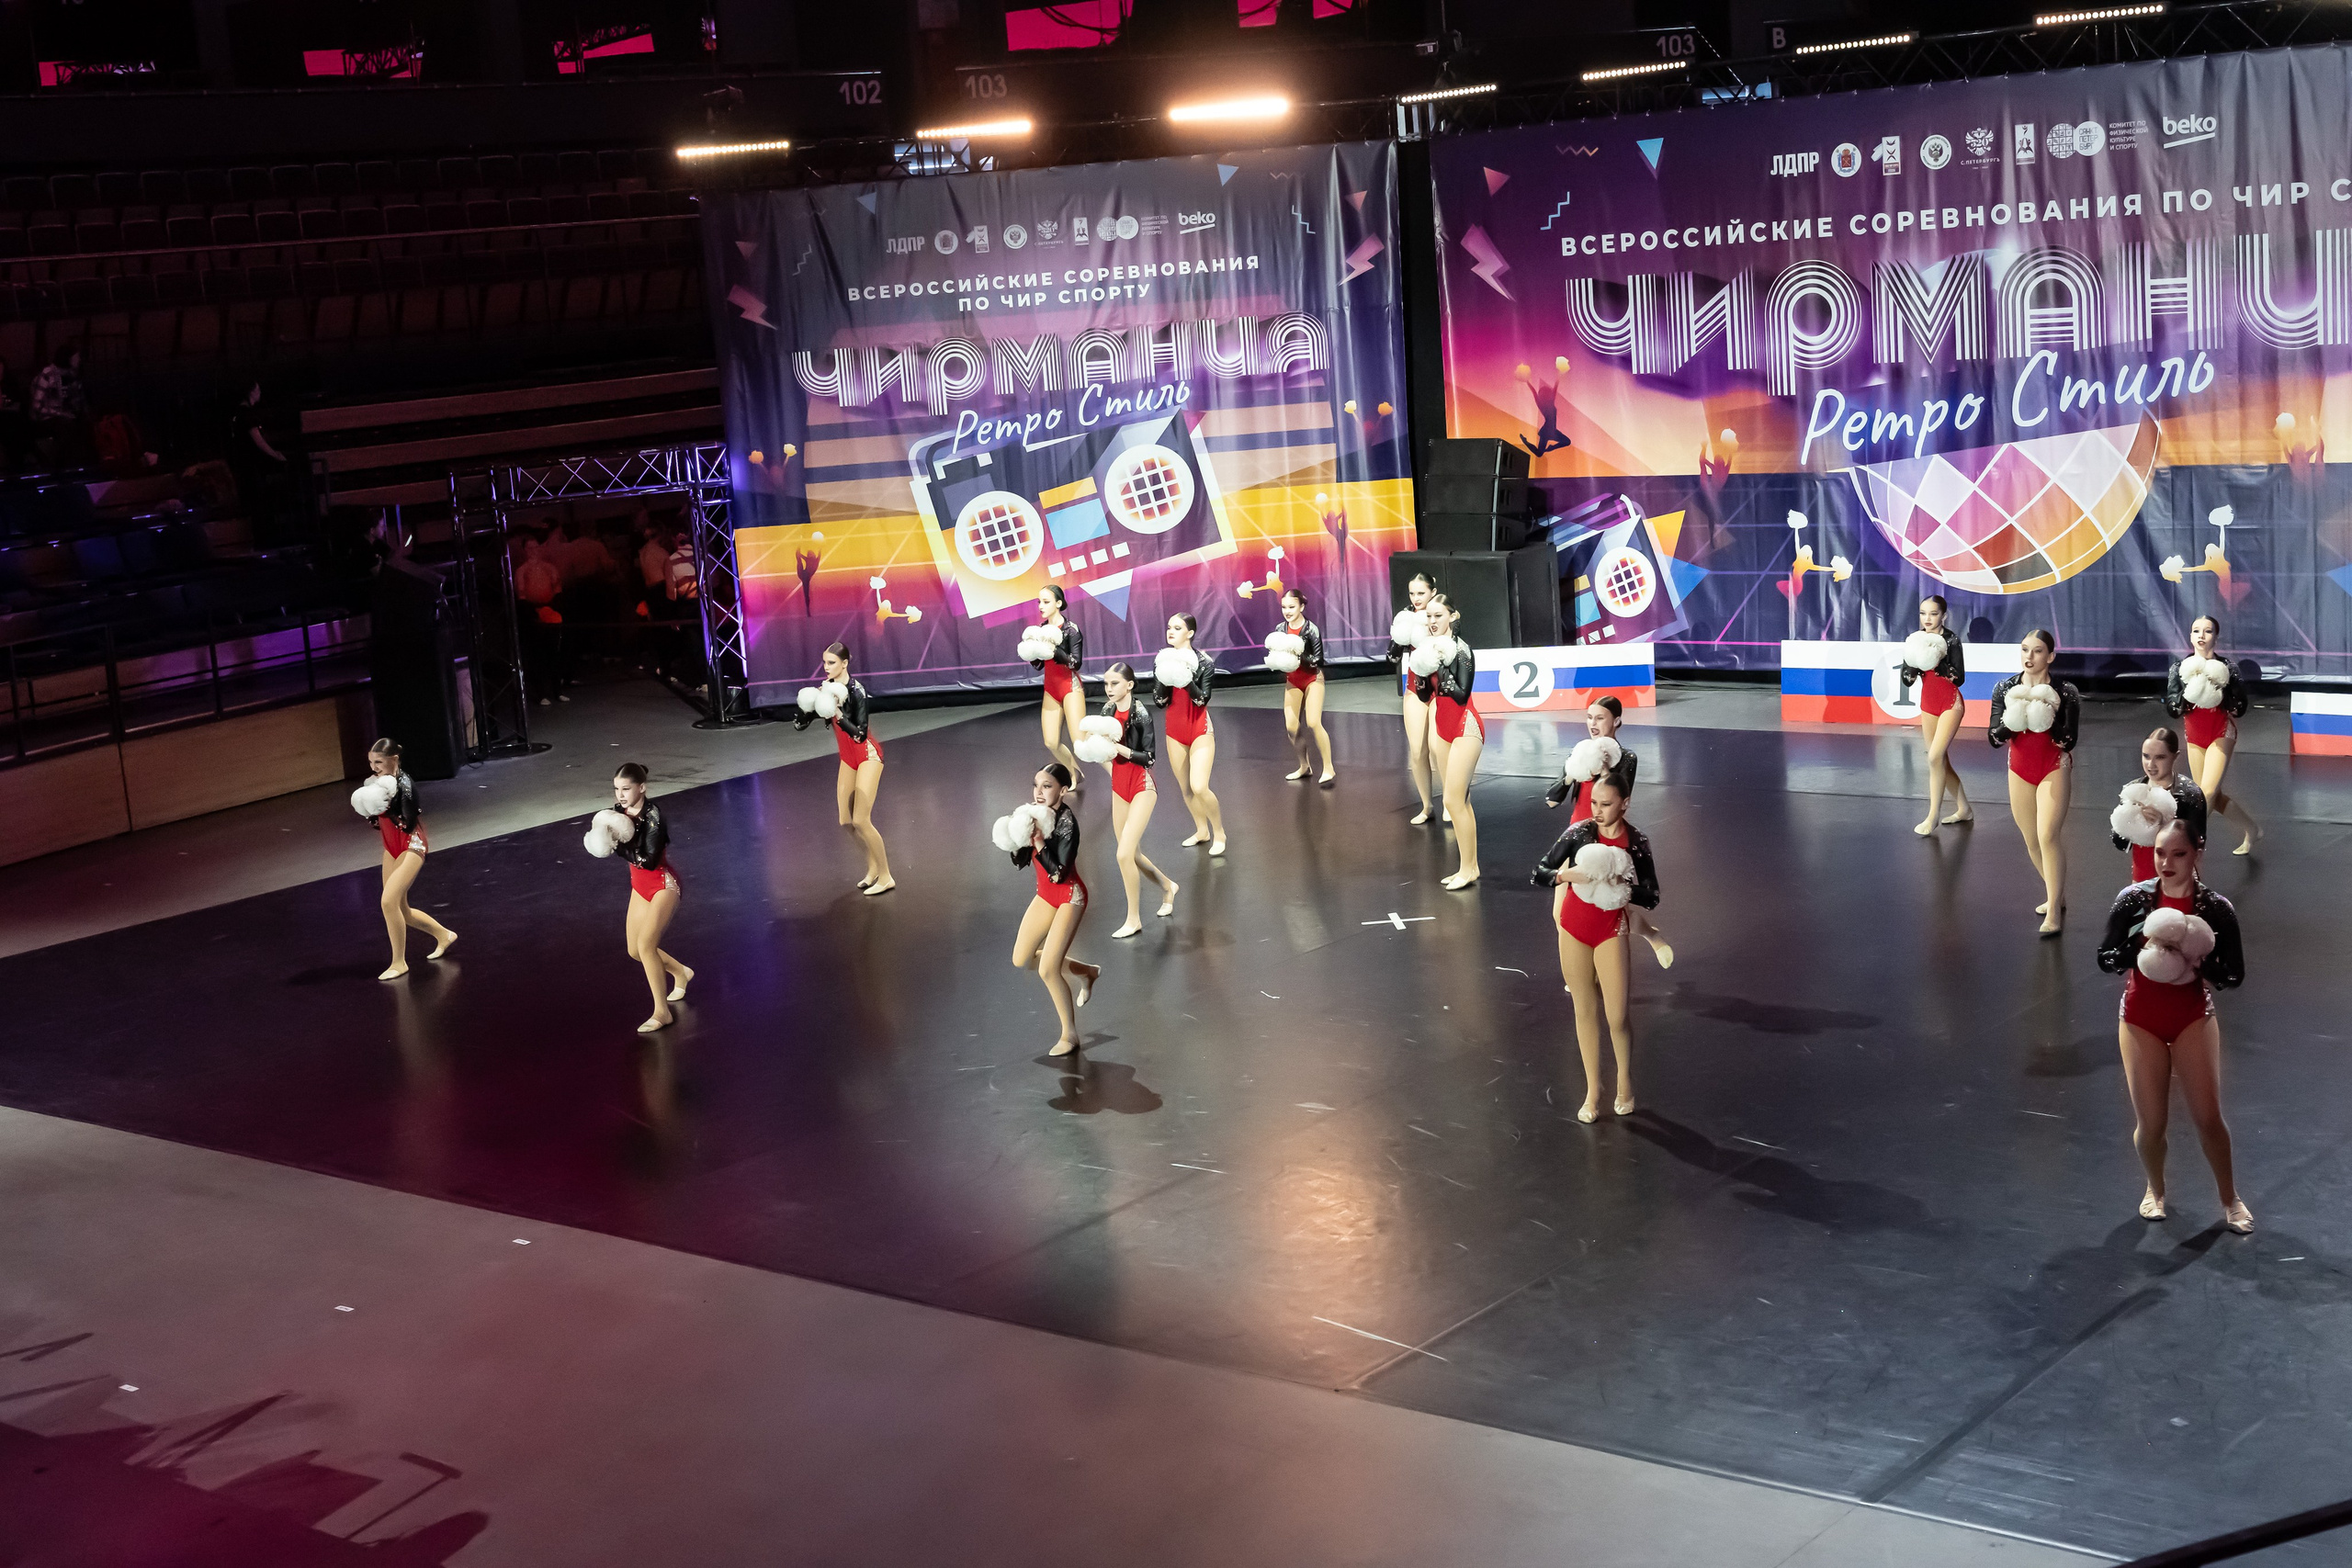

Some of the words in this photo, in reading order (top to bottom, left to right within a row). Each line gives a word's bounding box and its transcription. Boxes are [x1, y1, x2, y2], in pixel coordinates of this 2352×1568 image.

[1657, 34, 1695, 57] 103
[839, 80, 882, 105] 102
[966, 73, 1008, 99] 103
[2109, 120, 2136, 129] КОМИТЕТ
[2109, 126, 2149, 136] ФИЗИЧЕСКОЙ
[2163, 113, 2217, 136] beko
[2115, 142, 2138, 151] СПОРТУ
[1770, 152, 1820, 177] ЛДПР
[1178, 210, 1216, 226] beko
[1561, 217, 1834, 256] ВСЕРОССИЙСКИЕ
[1849, 194, 2142, 235] СОРЕВНОВАНИЯ
[2163, 188, 2213, 213] ПО
[2233, 182, 2310, 208] ЧИР
[886, 236, 925, 254] ЛДПР
[847, 272, 1053, 301] ВСЕРОССИЙСКИЕ
[1064, 255, 1260, 284] СОРЕВНОВАНИЯ
[958, 297, 989, 311] ПО
[1001, 292, 1047, 308] ЧИР
[1058, 284, 1150, 304] СПОРТУ
[952, 409, 1063, 455] Ретро
[1079, 380, 1191, 427] Стиль
[1800, 388, 1985, 466] Ретро
[2011, 349, 2215, 427] Стиль
[1513, 661, 1540, 698] 2
[1893, 659, 1916, 706] 1
